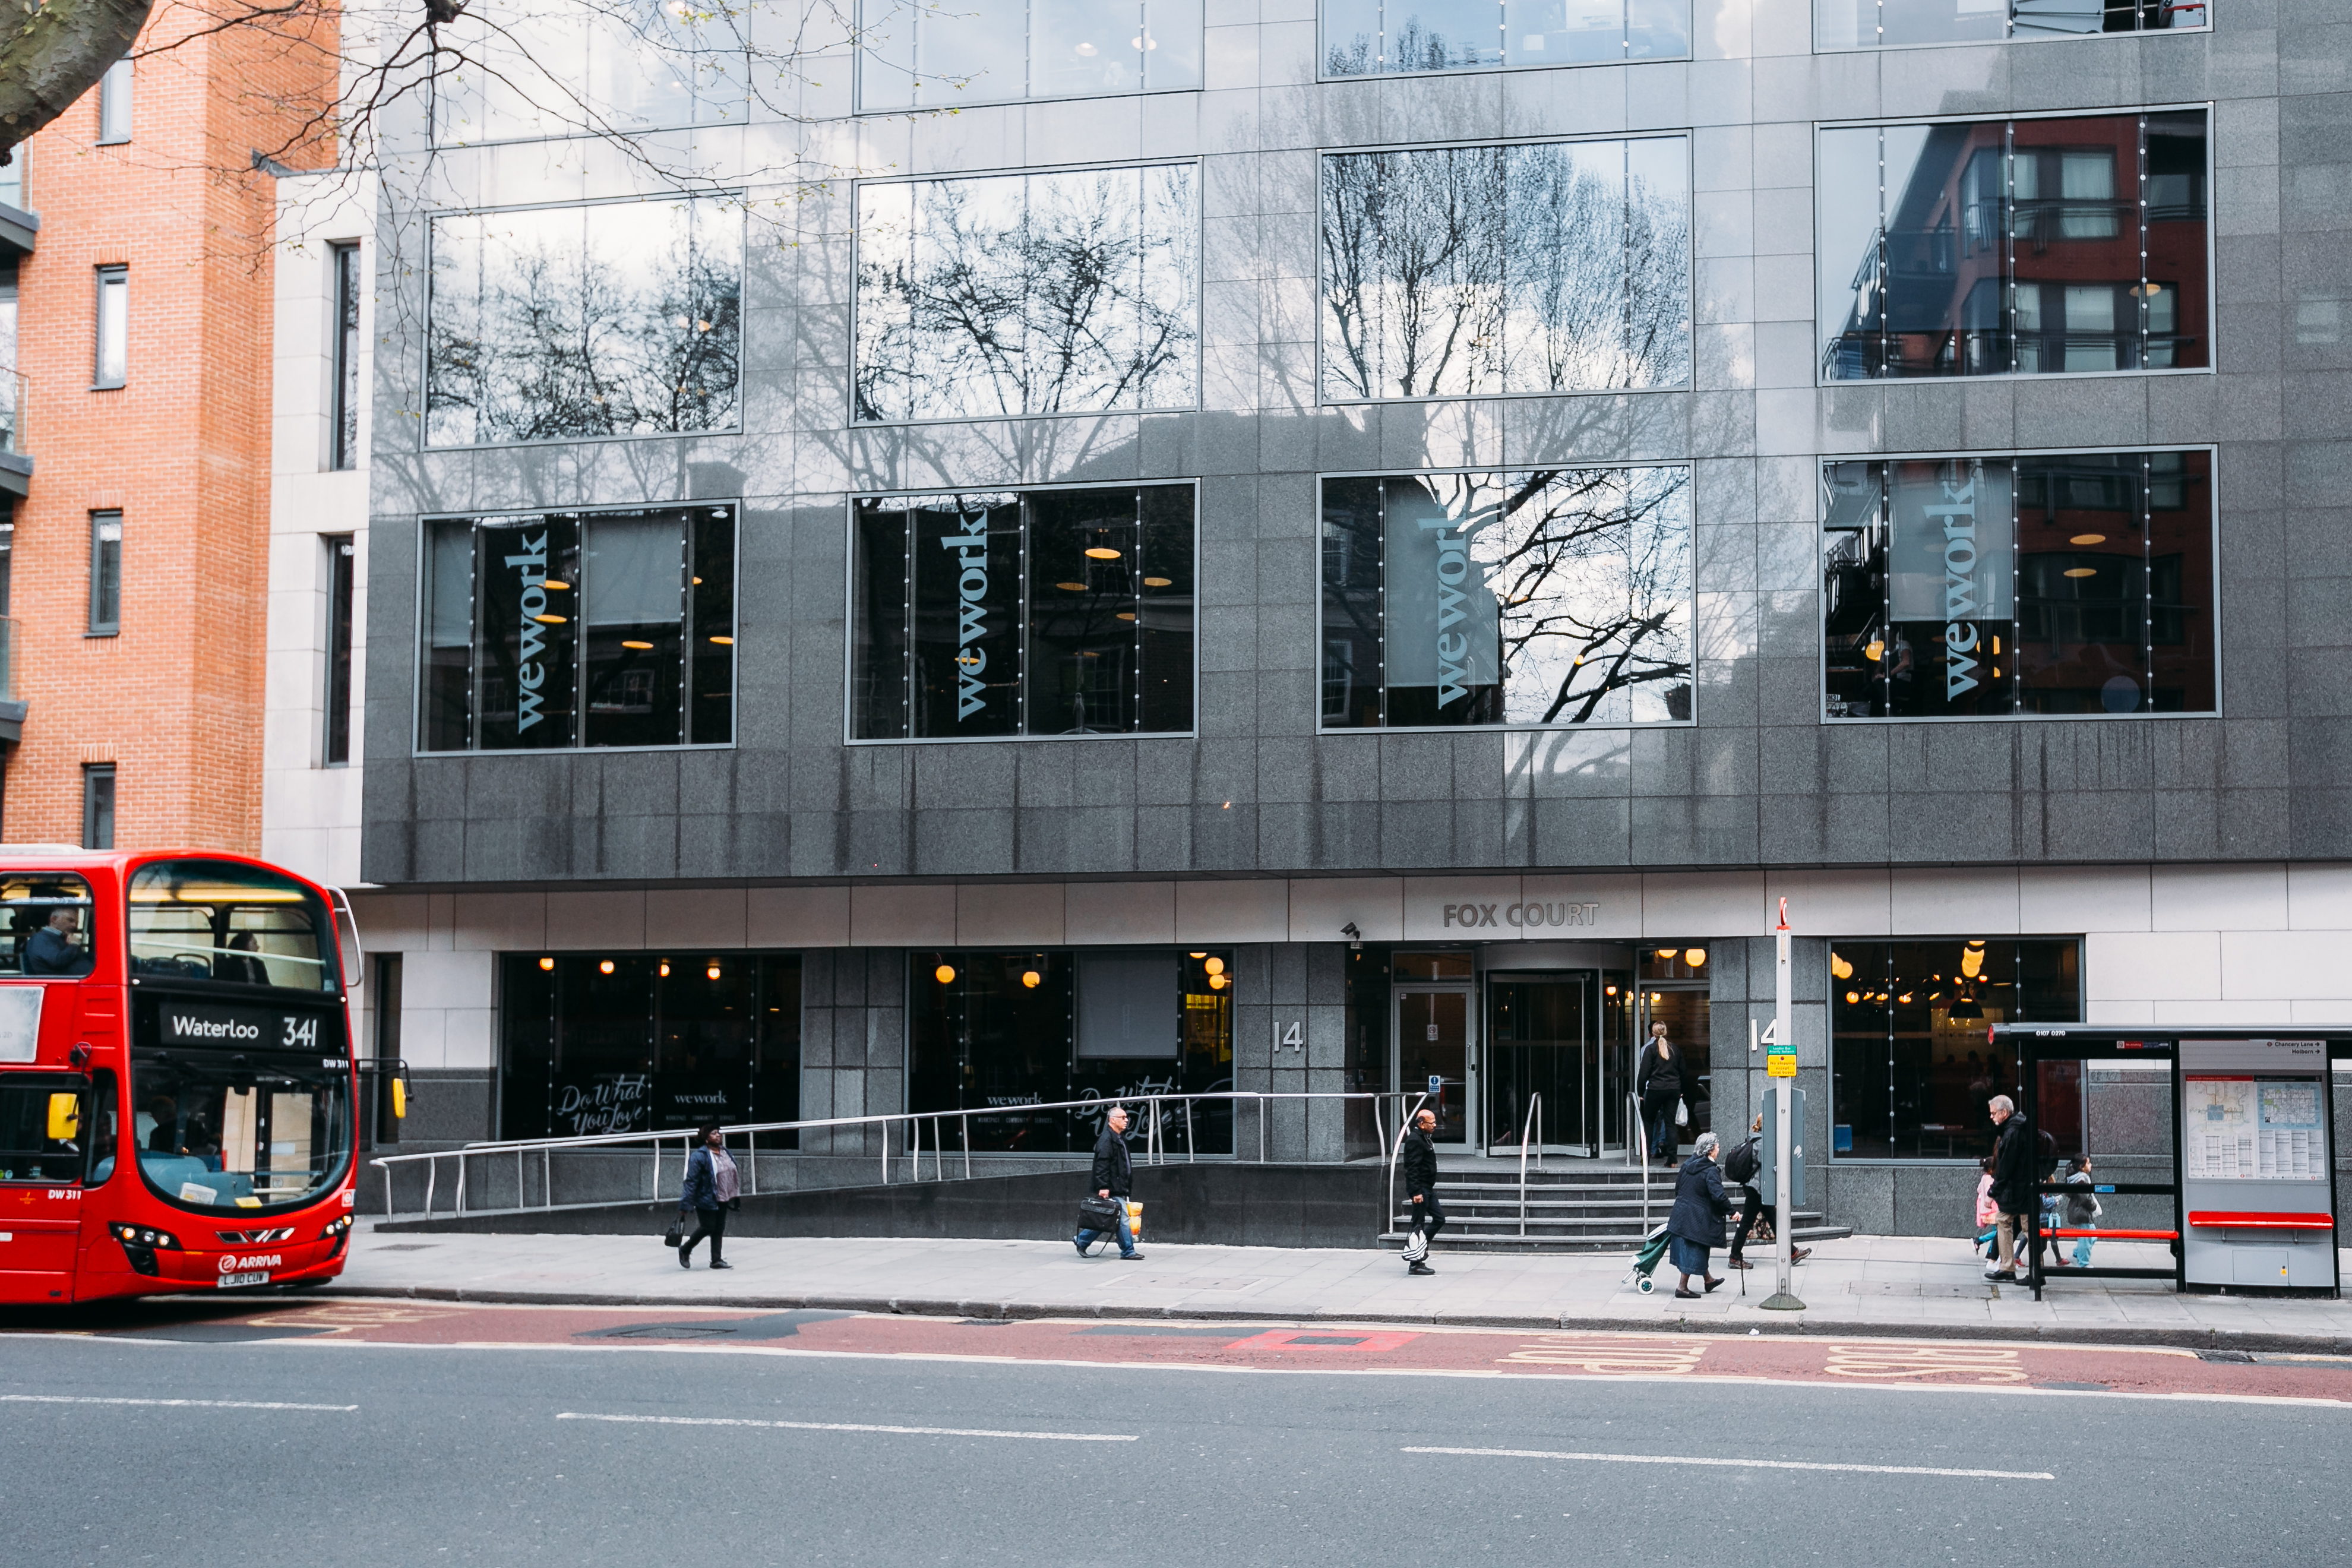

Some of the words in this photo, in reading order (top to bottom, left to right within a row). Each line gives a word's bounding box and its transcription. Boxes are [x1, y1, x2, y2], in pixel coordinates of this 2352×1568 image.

[1417, 489, 1468, 710] wework
[1923, 476, 1978, 701] wework
[941, 509, 987, 722] wework
[505, 530, 547, 734] wework
[1444, 904, 1497, 927] FOX
[1506, 902, 1599, 927] COURT
[173, 1016, 258, 1039] Waterloo
[283, 1016, 317, 1047] 341
[1274, 1021, 1304, 1052] 14
[1750, 1019, 1777, 1051] 14
[323, 1059, 336, 1068] DW
[337, 1060, 349, 1068] 311
[557, 1086, 594, 1116] Do
[593, 1074, 646, 1105] What
[675, 1090, 727, 1104] wework
[987, 1092, 1043, 1105] wework
[570, 1112, 610, 1136] You
[600, 1102, 645, 1134] Love
[48, 1190, 65, 1200] DW
[66, 1190, 81, 1200] 311
[236, 1254, 282, 1269] ARRIVA
